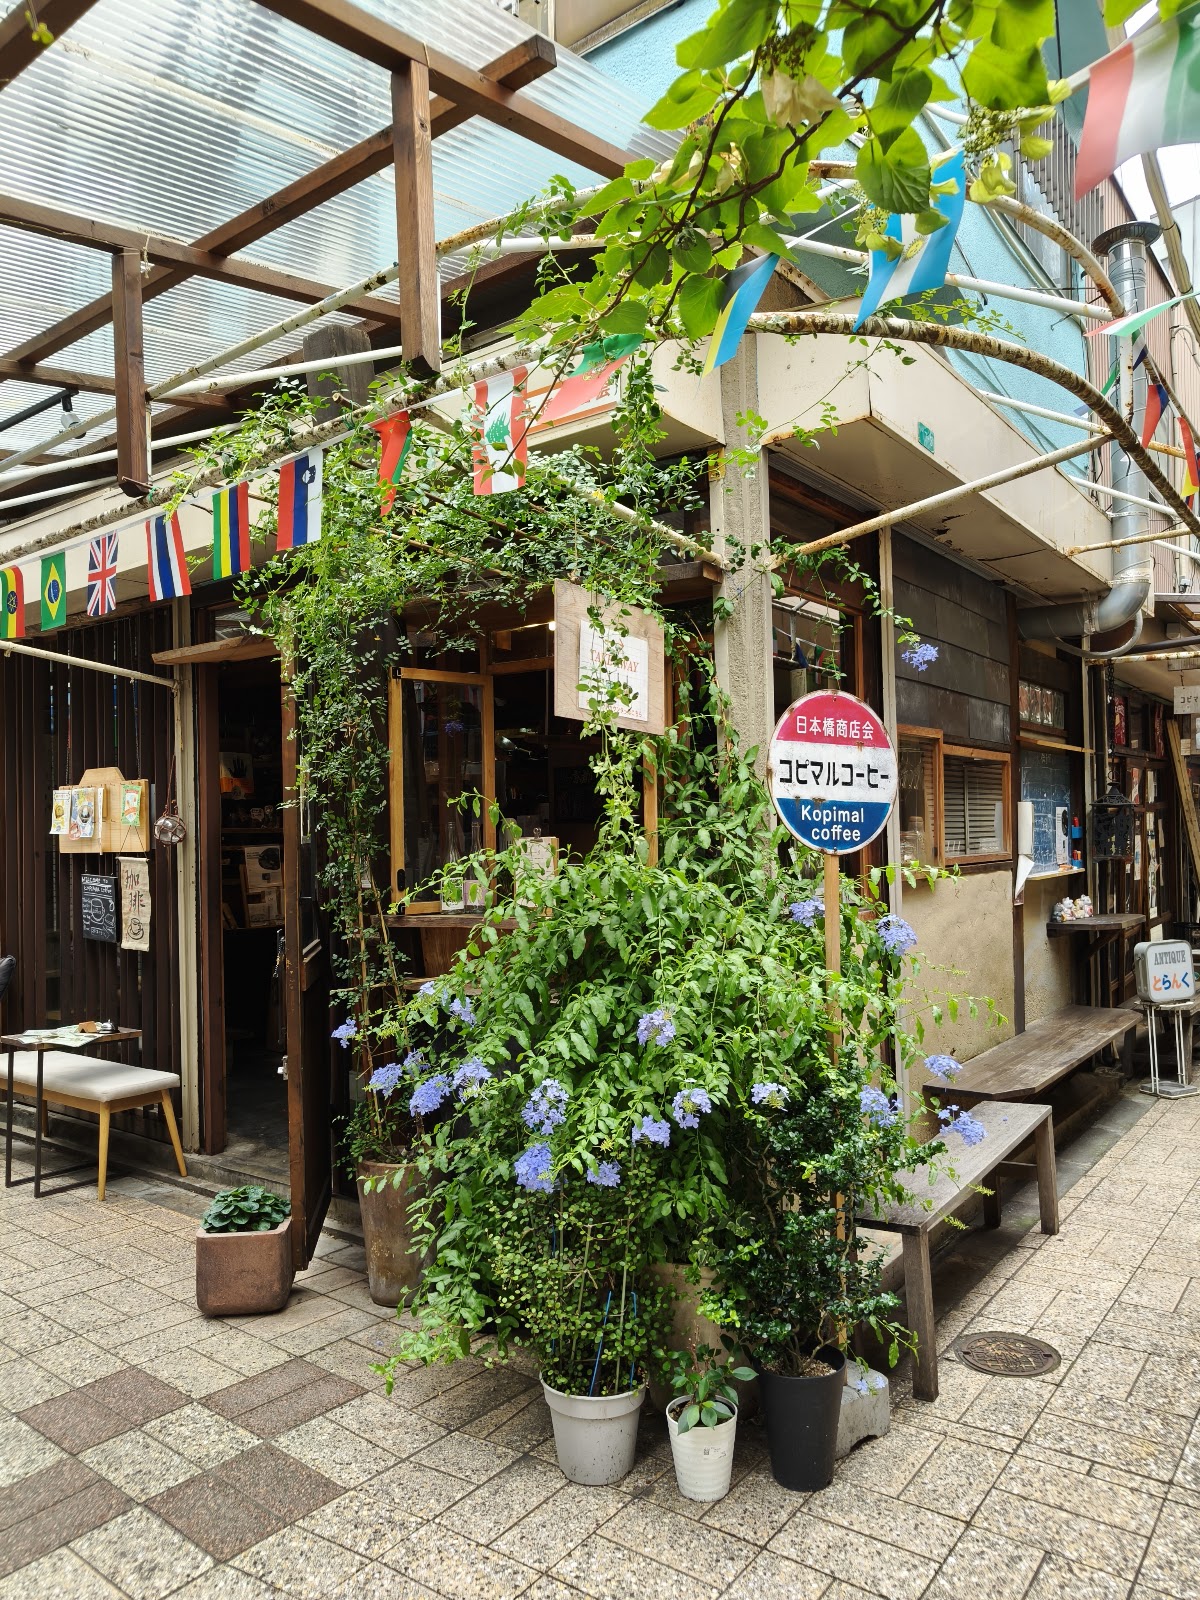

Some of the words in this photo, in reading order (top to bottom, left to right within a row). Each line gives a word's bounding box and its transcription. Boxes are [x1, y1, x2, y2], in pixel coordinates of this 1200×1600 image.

[617, 659, 640, 672] WAY
[796, 715, 874, 741] 日本橋商店会
[779, 759, 889, 789] コピマルコーヒー
[801, 804, 864, 824] Kopimal
[811, 825, 861, 841] coffee
[1154, 950, 1186, 965] ANTIQUE
[1152, 972, 1190, 991] とらんく
